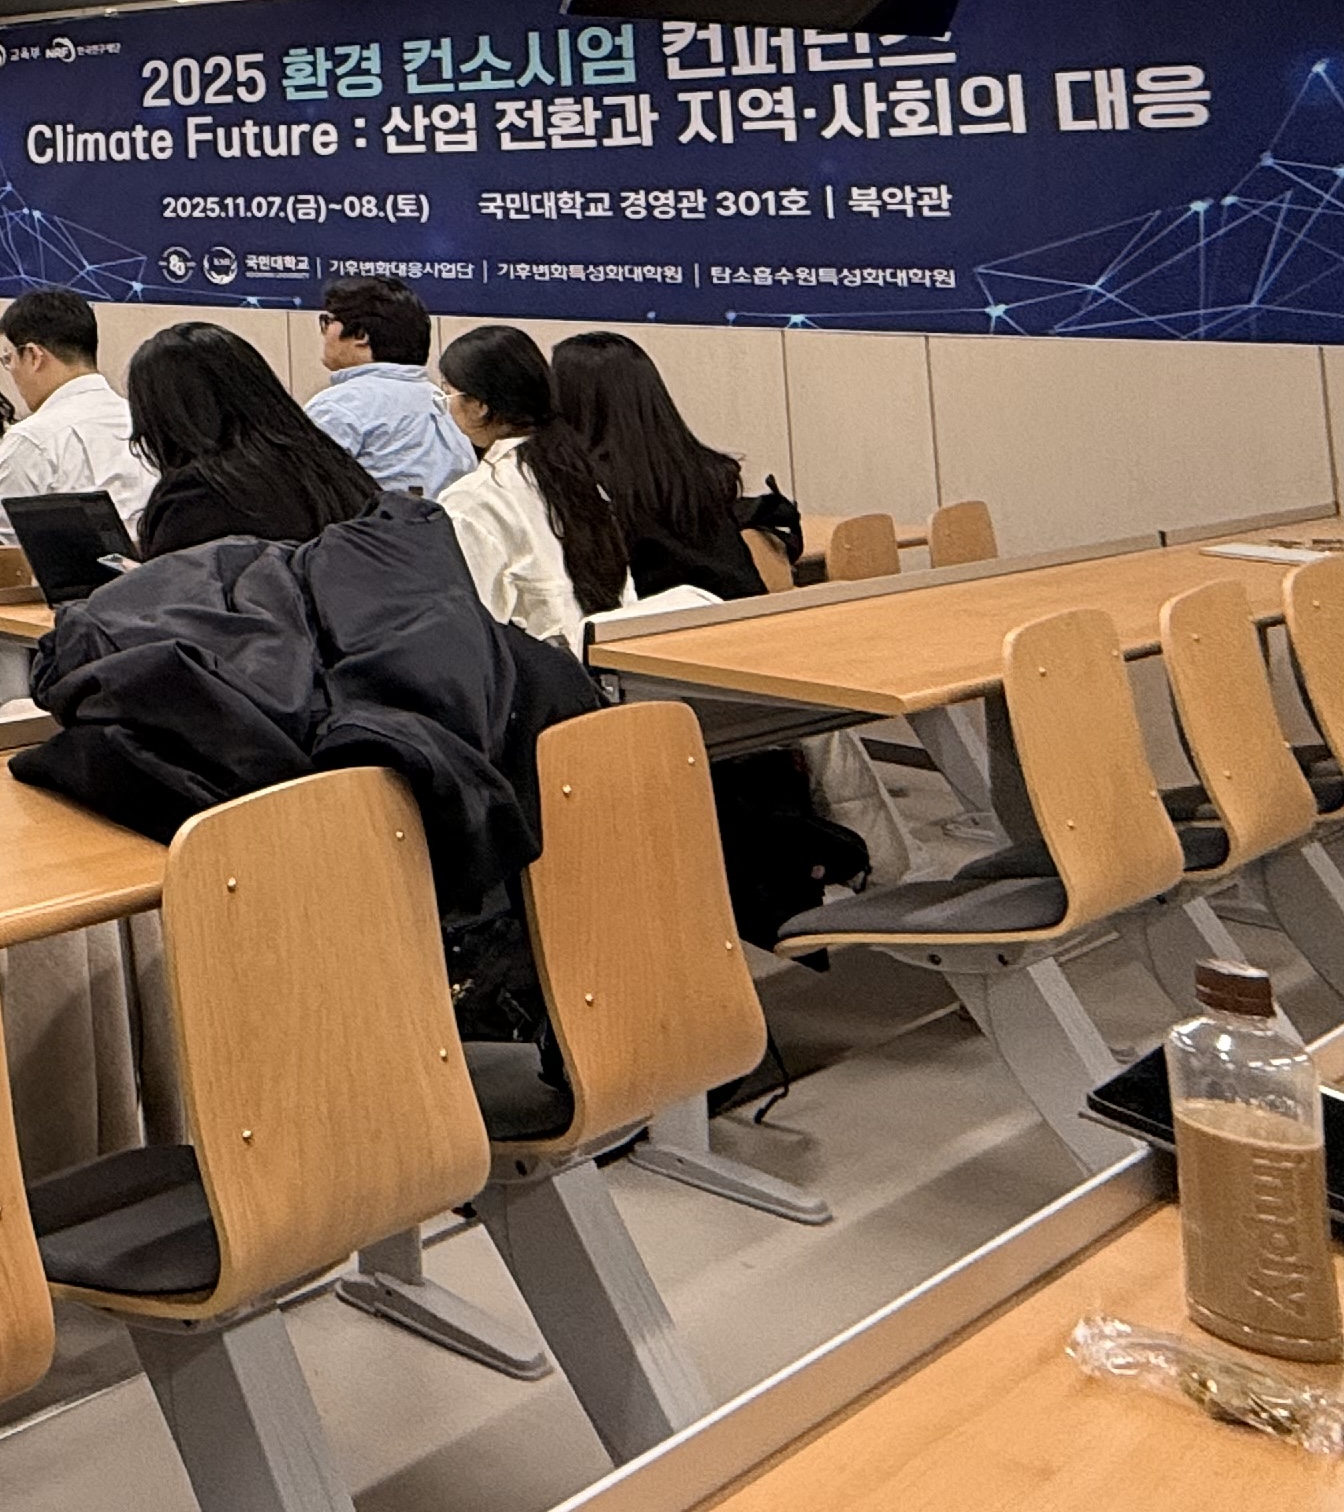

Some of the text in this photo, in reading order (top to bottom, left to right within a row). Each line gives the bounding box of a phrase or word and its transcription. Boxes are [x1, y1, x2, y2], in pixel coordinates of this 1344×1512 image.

[142, 53, 266, 108] 2025
[282, 43, 383, 100] 환경
[403, 24, 635, 94] 컨소시엄
[27, 124, 173, 164] Climate
[187, 116, 338, 159] Future
[381, 102, 478, 154] 산업
[495, 94, 659, 151] 전환과
[677, 73, 1027, 144] 지역·사회의
[1054, 65, 1211, 131] 대응
[162, 184, 953, 223] 2025.11.07.(금)~08.(토) 국민대학교 경영관 301호 북악관
[245, 254, 310, 271] 국민대학교
